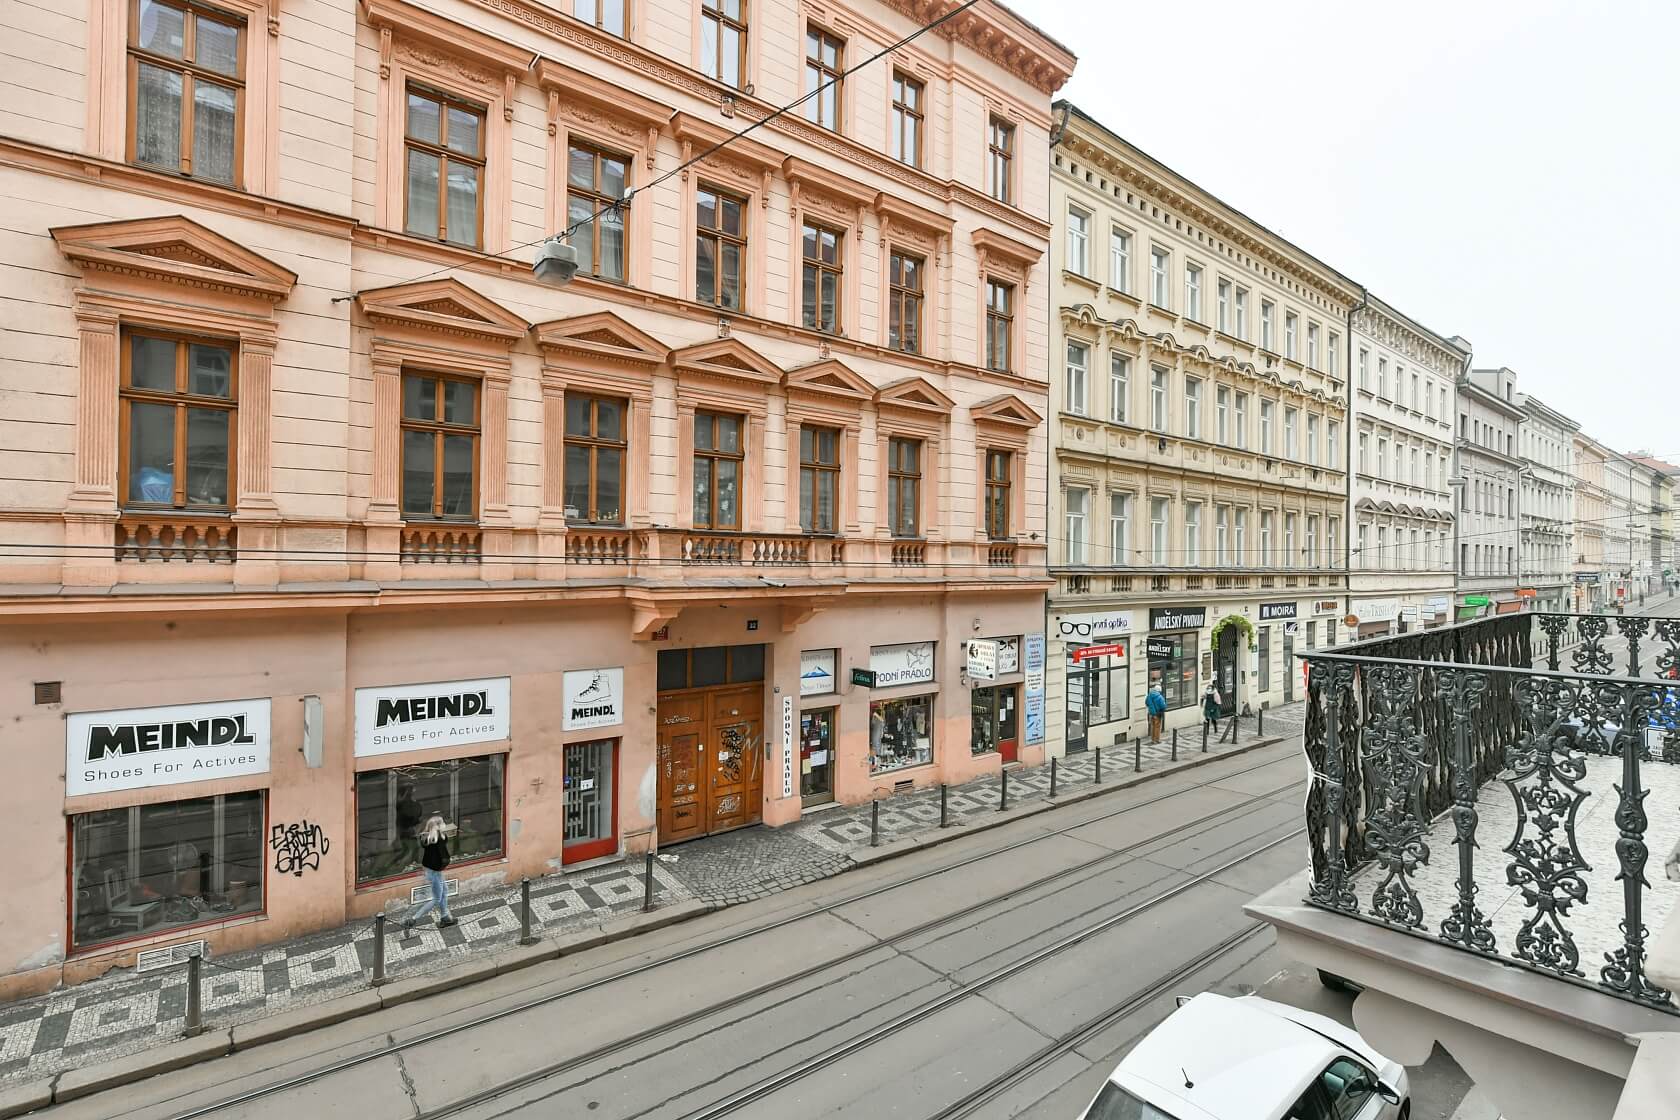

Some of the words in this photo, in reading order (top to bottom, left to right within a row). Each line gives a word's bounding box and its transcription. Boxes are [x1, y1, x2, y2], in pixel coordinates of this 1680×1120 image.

[1271, 605, 1294, 617] MOIRA
[1093, 618, 1107, 629] rvní
[1109, 618, 1128, 630] optika
[1183, 614, 1204, 628] PIVOVAR
[875, 668, 899, 682] PODNÍ
[900, 667, 931, 681] PRÁDLO
[374, 690, 495, 730] MEINDL
[571, 704, 615, 721] MEINDL
[86, 713, 256, 762] MEINDL
[373, 734, 415, 746] Shoes
[422, 730, 444, 740] For
[449, 724, 496, 736] Actives
[84, 766, 143, 782] Shoes
[153, 761, 183, 774] For
[193, 754, 257, 769] Actives
